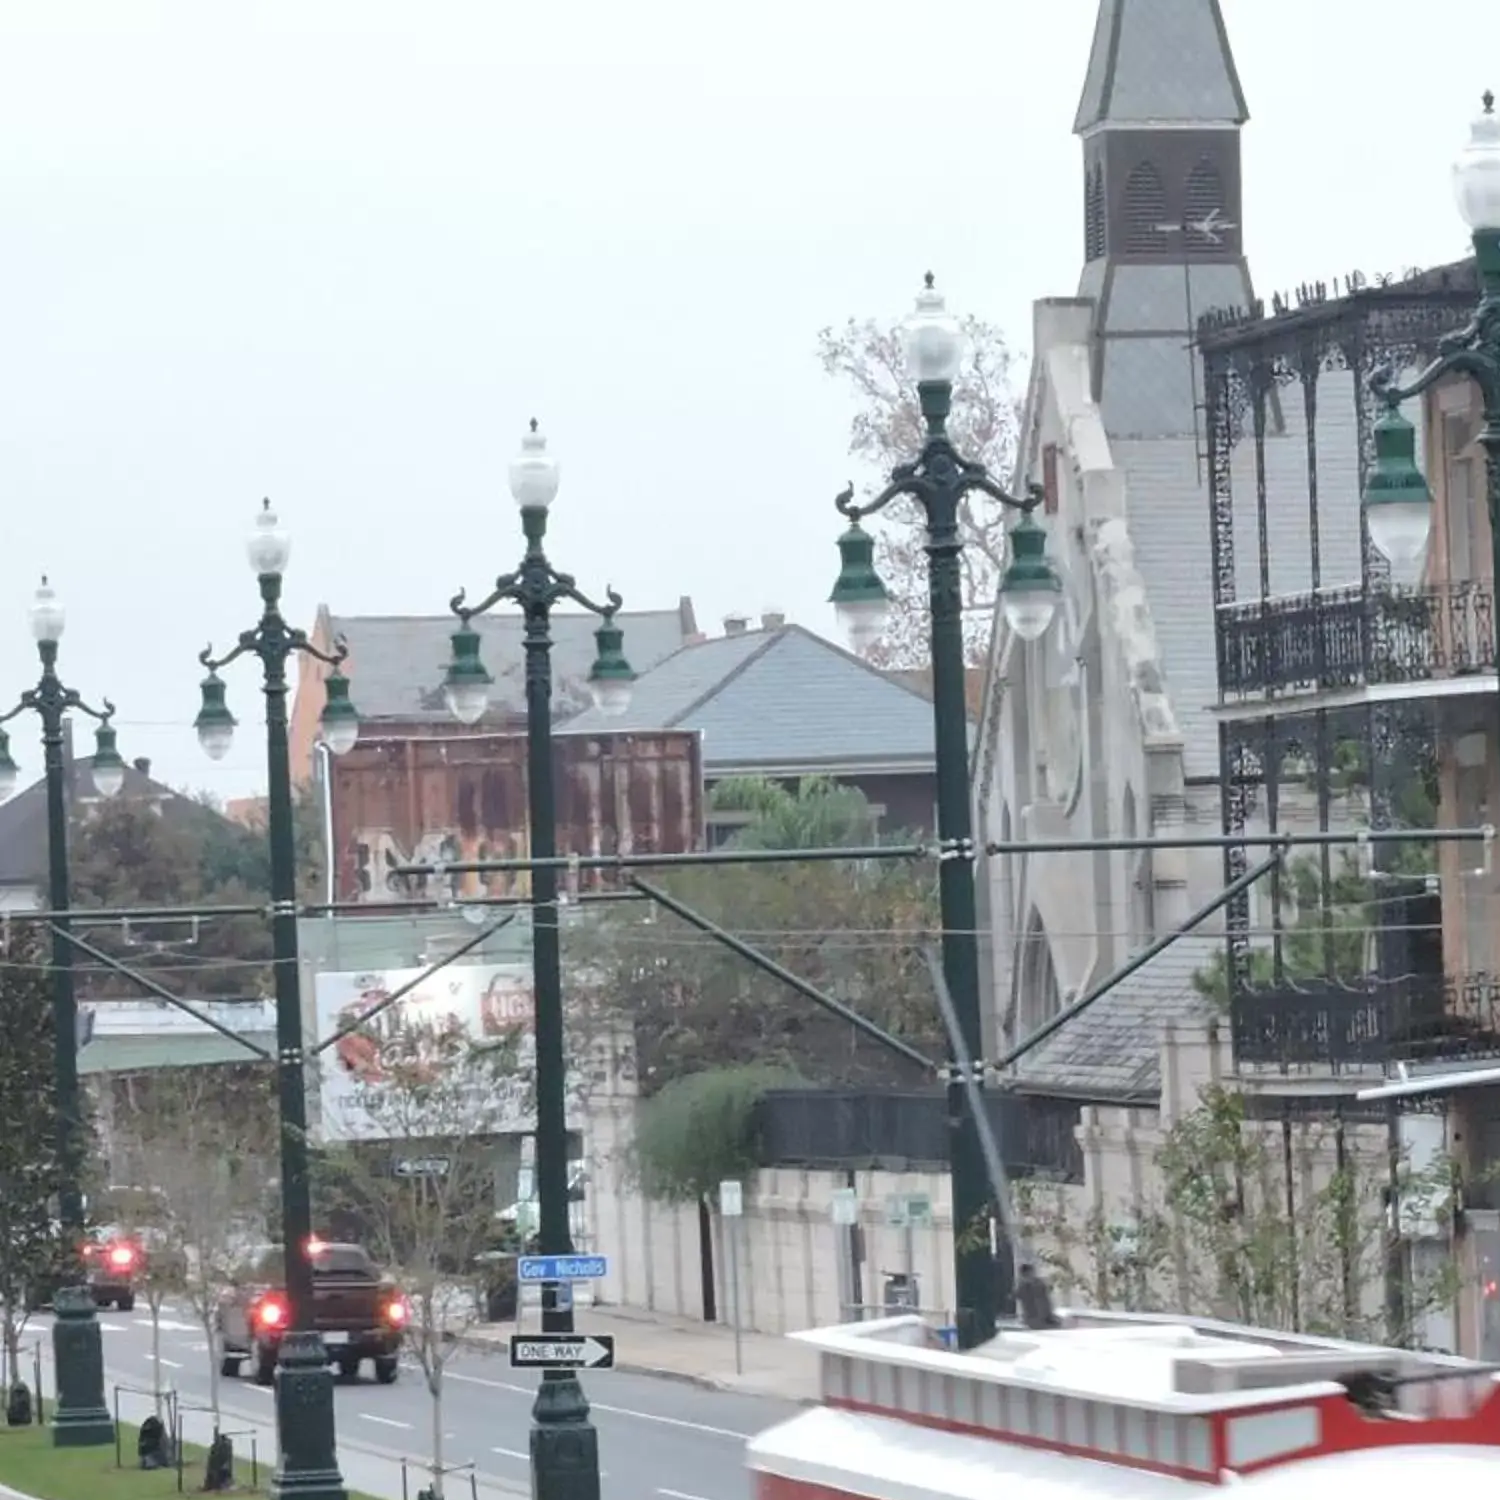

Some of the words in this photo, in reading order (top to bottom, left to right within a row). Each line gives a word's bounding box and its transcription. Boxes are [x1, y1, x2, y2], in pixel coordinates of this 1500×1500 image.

[523, 1262, 546, 1276] Gov
[520, 1344, 550, 1358] ONE
[554, 1344, 582, 1358] WAY
